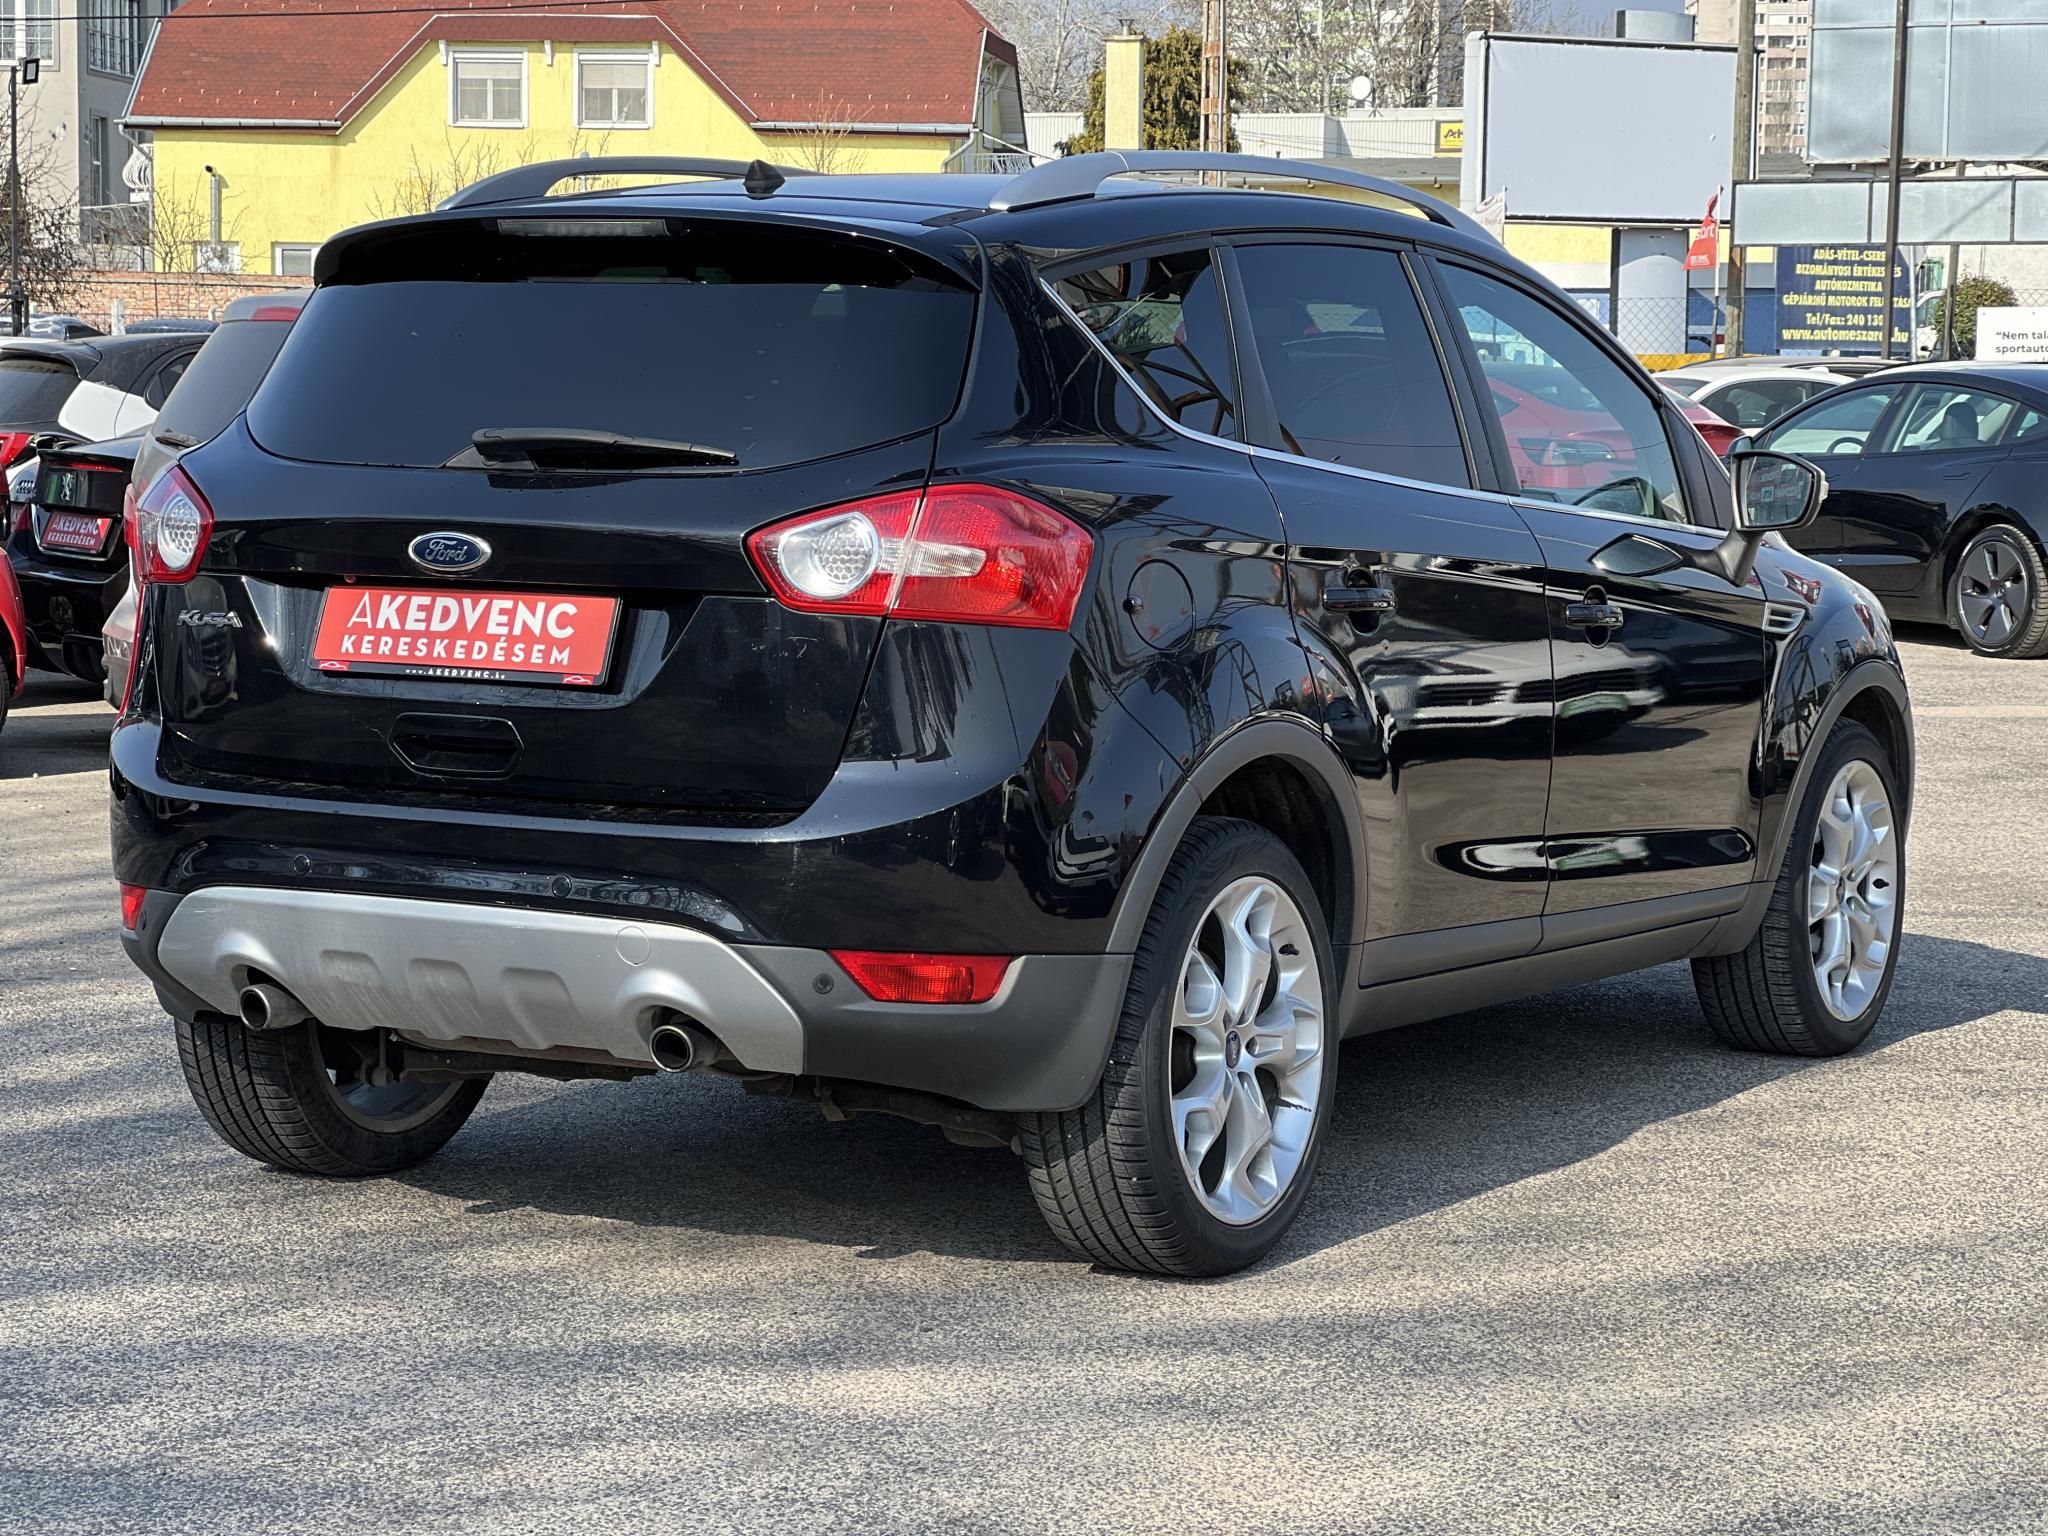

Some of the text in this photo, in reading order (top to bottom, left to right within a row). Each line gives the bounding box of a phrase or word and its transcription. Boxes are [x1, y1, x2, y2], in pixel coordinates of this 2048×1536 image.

[1813, 247, 1887, 262] ADÁS-VÉTEL-CSERE
[1795, 262, 1851, 277] BIZOMÁNYOSI
[1814, 278, 1883, 292] AUTÓKOZMETIKA
[1827, 296, 1868, 307] MOTOROK
[1805, 312, 1846, 326] Tel/Fax:
[1846, 314, 1865, 326] 240
[425, 538, 468, 562] Ford
[347, 591, 579, 640] AKEDVENC
[341, 634, 571, 666] KERESKEDÉSEM
